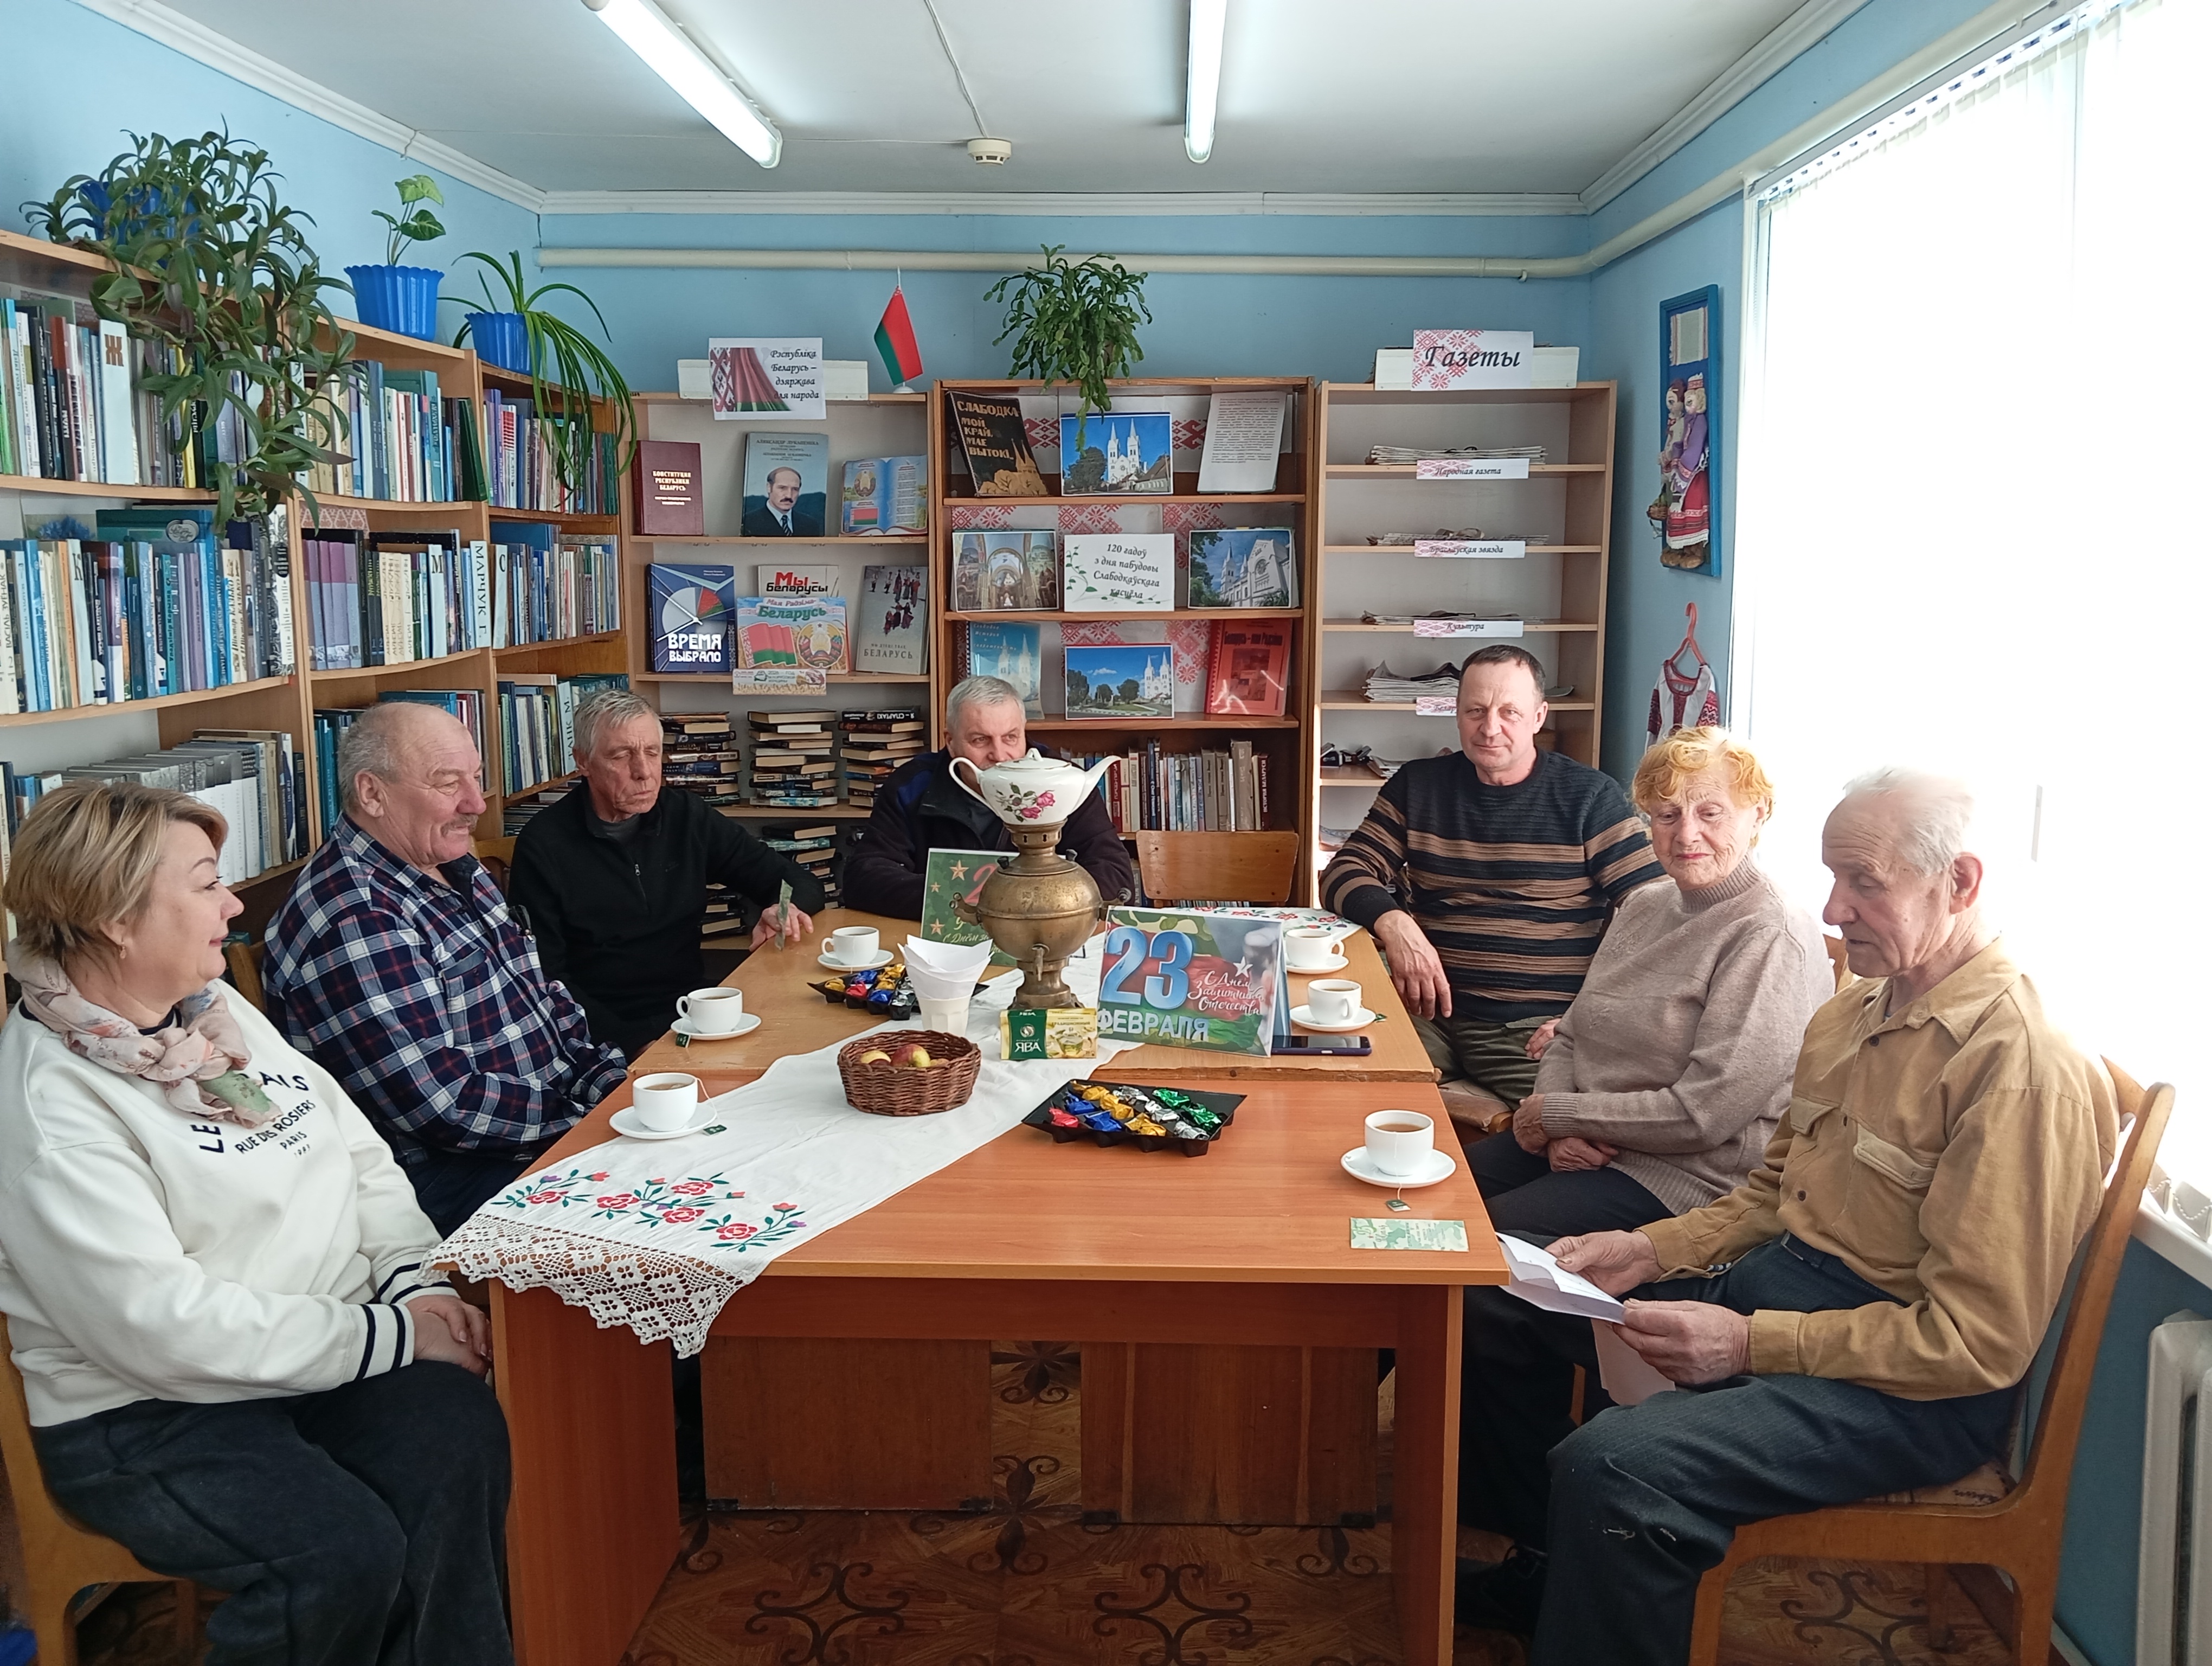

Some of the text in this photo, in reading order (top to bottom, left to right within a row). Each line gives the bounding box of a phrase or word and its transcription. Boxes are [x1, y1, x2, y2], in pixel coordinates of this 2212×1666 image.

[105, 334, 124, 367] Ж
[770, 349, 816, 361] Рэспубліка
[1425, 344, 1520, 368] Газеты
[771, 363, 809, 374] Беларусь
[775, 376, 815, 388] дзяржава
[791, 389, 819, 401] народа
[961, 417, 986, 427] МОЙ
[1435, 467, 1474, 477] Народная
[1107, 544, 1147, 559] 120 гадоў
[1478, 544, 1503, 553] звязда
[431, 554, 443, 574] М
[499, 554, 506, 573] С
[1101, 555, 1117, 567] дня
[1119, 560, 1159, 573] пабудовы
[475, 545, 487, 616] МАРЧУК
[774, 572, 808, 586] Мы
[1093, 570, 1160, 587] Слабодкаўскага
[766, 582, 828, 595] беларусы
[758, 605, 827, 622] Беларусь
[1446, 622, 1484, 632] Культура
[667, 633, 722, 650] ВРЕМЯ
[668, 650, 722, 664] ВЫБРАЛО
[864, 648, 913, 659] БЕЛАРУСЬ
[1099, 925, 1194, 1010] 23
[1204, 970, 1217, 986] С
[1187, 980, 1264, 1002] Защитника
[1198, 997, 1261, 1016] Отечества
[1097, 1008, 1210, 1042] ФЕВРАЛЯ
[1014, 1042, 1042, 1053] ЯВА
[235, 1134, 260, 1155] RUE
[272, 1099, 316, 1133] ROSIERS
[190, 1124, 224, 1154] LE
[280, 1131, 307, 1150] PARIS
